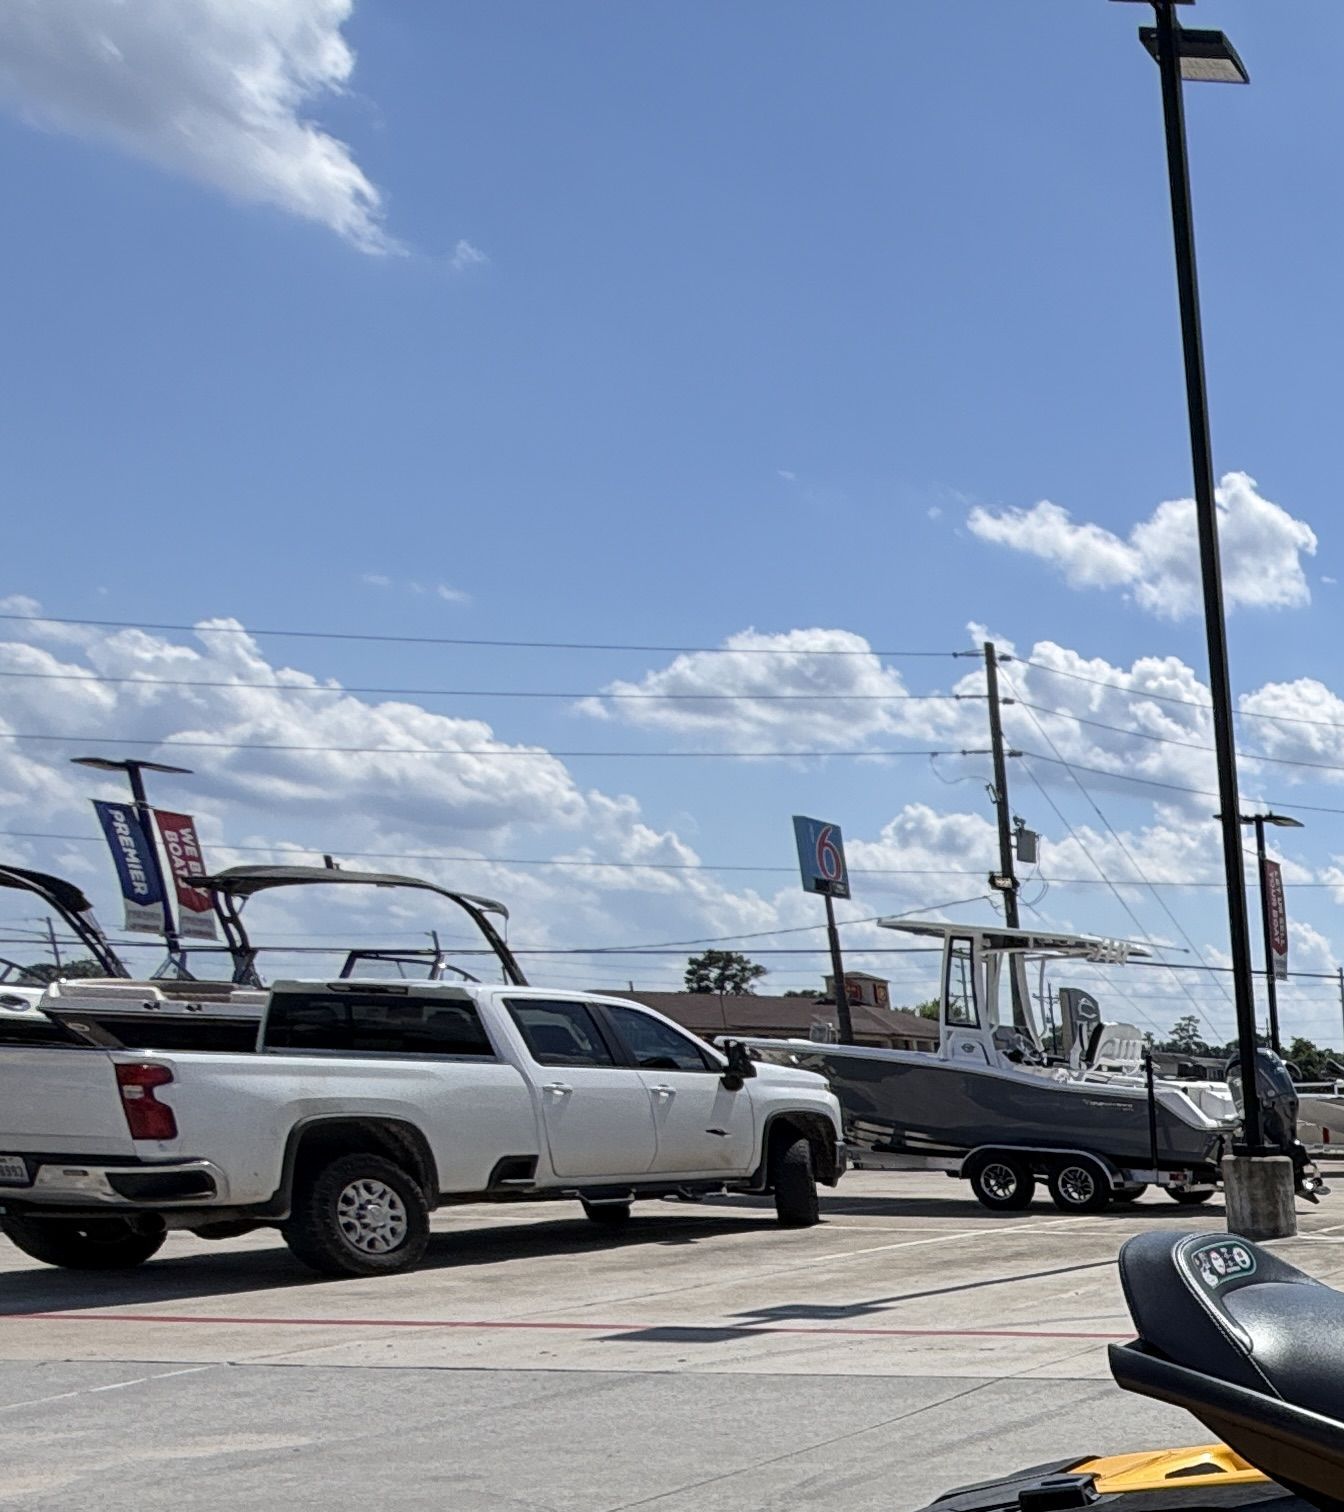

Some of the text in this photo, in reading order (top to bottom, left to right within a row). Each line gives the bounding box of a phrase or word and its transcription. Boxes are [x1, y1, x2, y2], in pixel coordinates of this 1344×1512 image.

[107, 808, 149, 896] PREMIER
[179, 827, 199, 857] WE
[816, 825, 842, 881] 6
[188, 859, 209, 898] BY
[1272, 909, 1280, 944] BOAT
